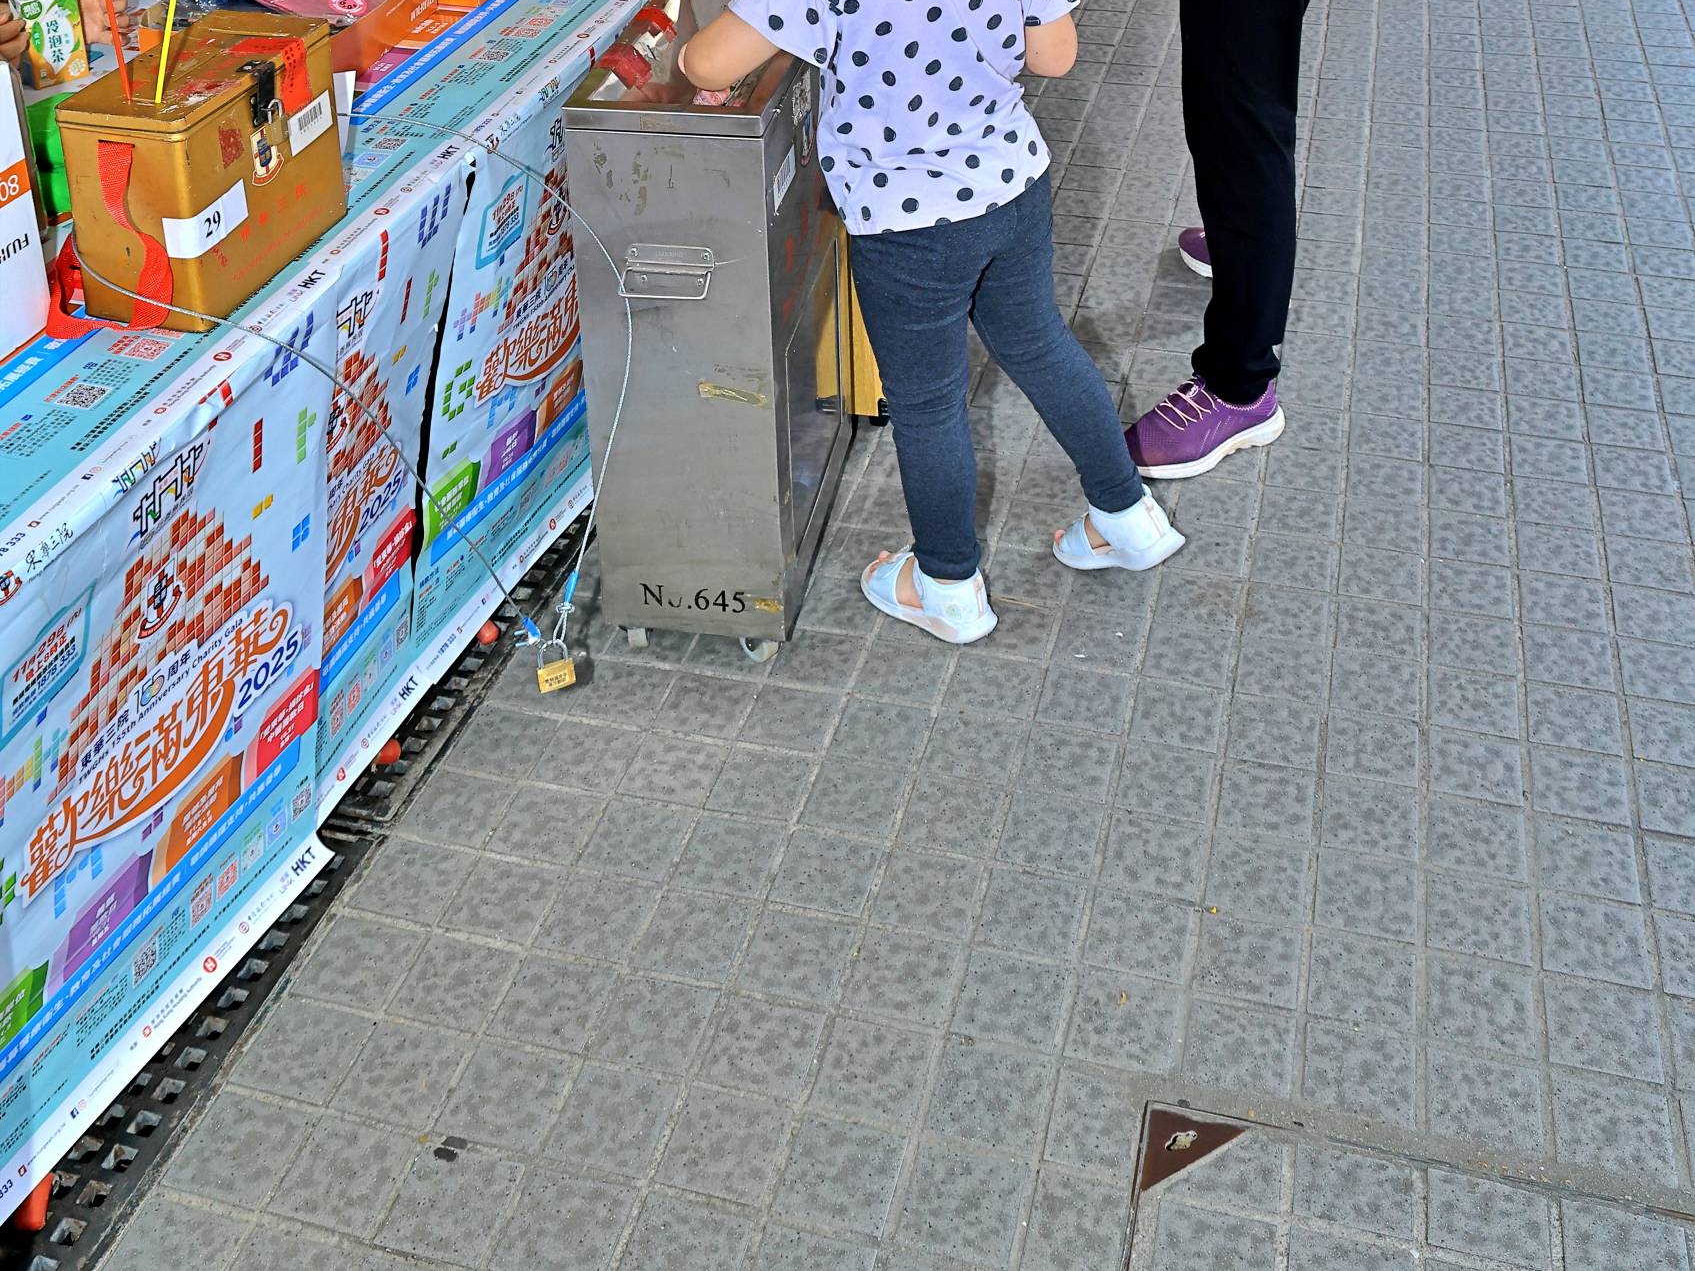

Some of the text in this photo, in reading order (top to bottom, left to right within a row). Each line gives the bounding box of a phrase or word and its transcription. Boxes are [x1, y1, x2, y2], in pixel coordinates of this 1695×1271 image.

[45, 19, 65, 65] 冷泡茶
[438, 144, 461, 160] HKT
[203, 210, 222, 239] 29
[298, 269, 326, 289] HKT
[359, 470, 402, 534] 2025
[238, 631, 299, 710] 2025
[398, 675, 419, 701] HKT
[79, 616, 244, 785] TWGHs 155th Anniversary Charity Gala
[21, 607, 289, 898] 歡樂滿東華
[80, 708, 130, 770] 東華三院
[291, 845, 316, 877] HKT
